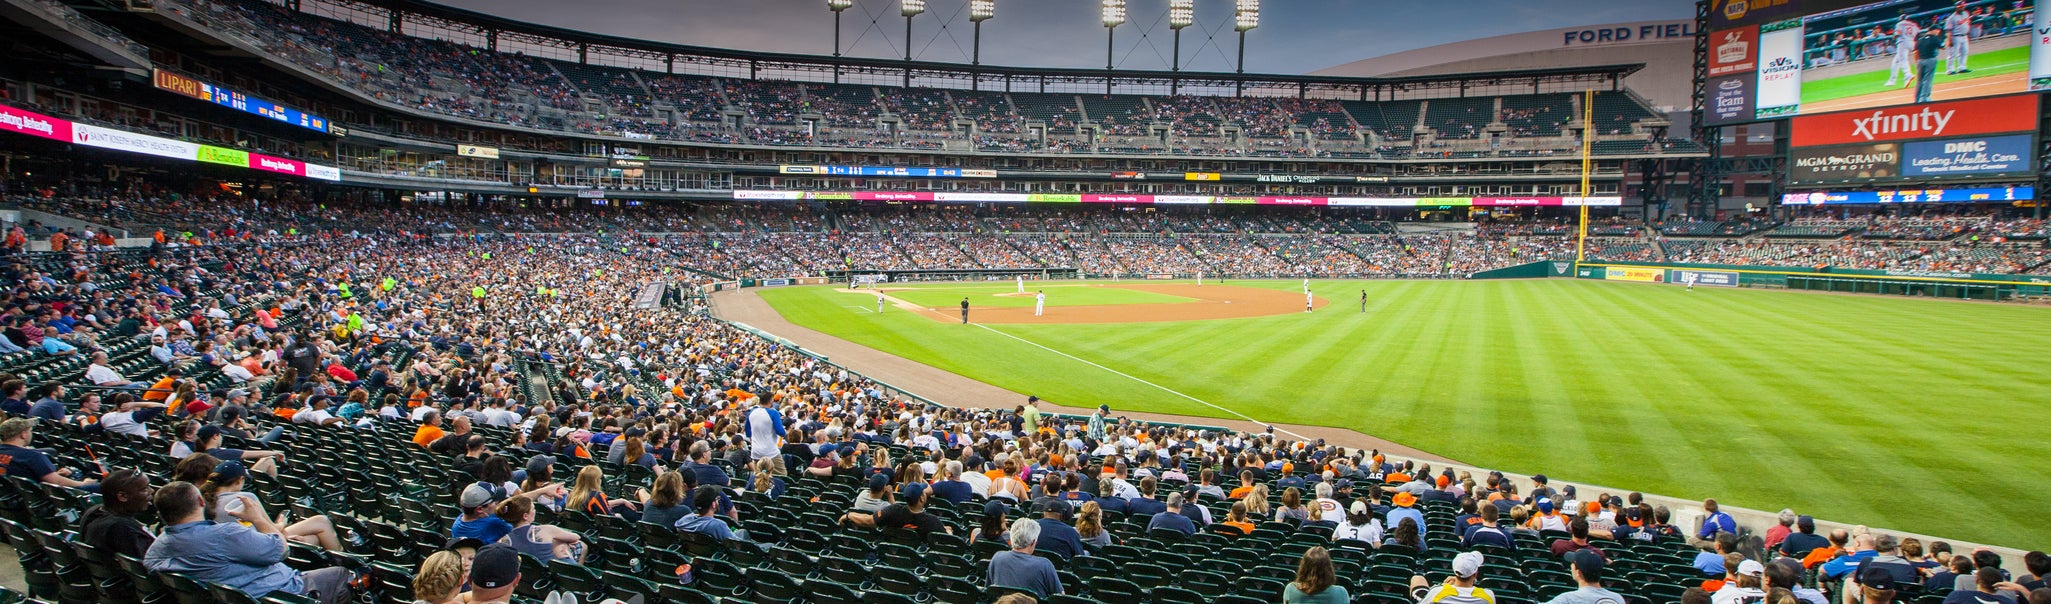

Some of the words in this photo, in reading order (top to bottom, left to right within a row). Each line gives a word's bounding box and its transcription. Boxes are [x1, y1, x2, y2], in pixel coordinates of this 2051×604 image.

[1728, 2, 1745, 15] NAPA
[1564, 27, 1631, 45] FORD
[1639, 24, 1696, 39] FIEL
[1720, 47, 1745, 56] NATIONAL
[1762, 64, 1799, 73] VISION
[161, 72, 197, 96] LIPARI
[1716, 96, 1744, 107] Team
[1852, 107, 1955, 140] xfinity
[1945, 141, 1987, 153] DMC
[1796, 157, 1827, 167] MGM
[1846, 153, 1893, 164] GRAND
[1812, 163, 1874, 172] DETROIT
[1257, 174, 1270, 182] JACK
[1271, 174, 1292, 182] DANIEL'S
[1350, 528, 1358, 540] 3
